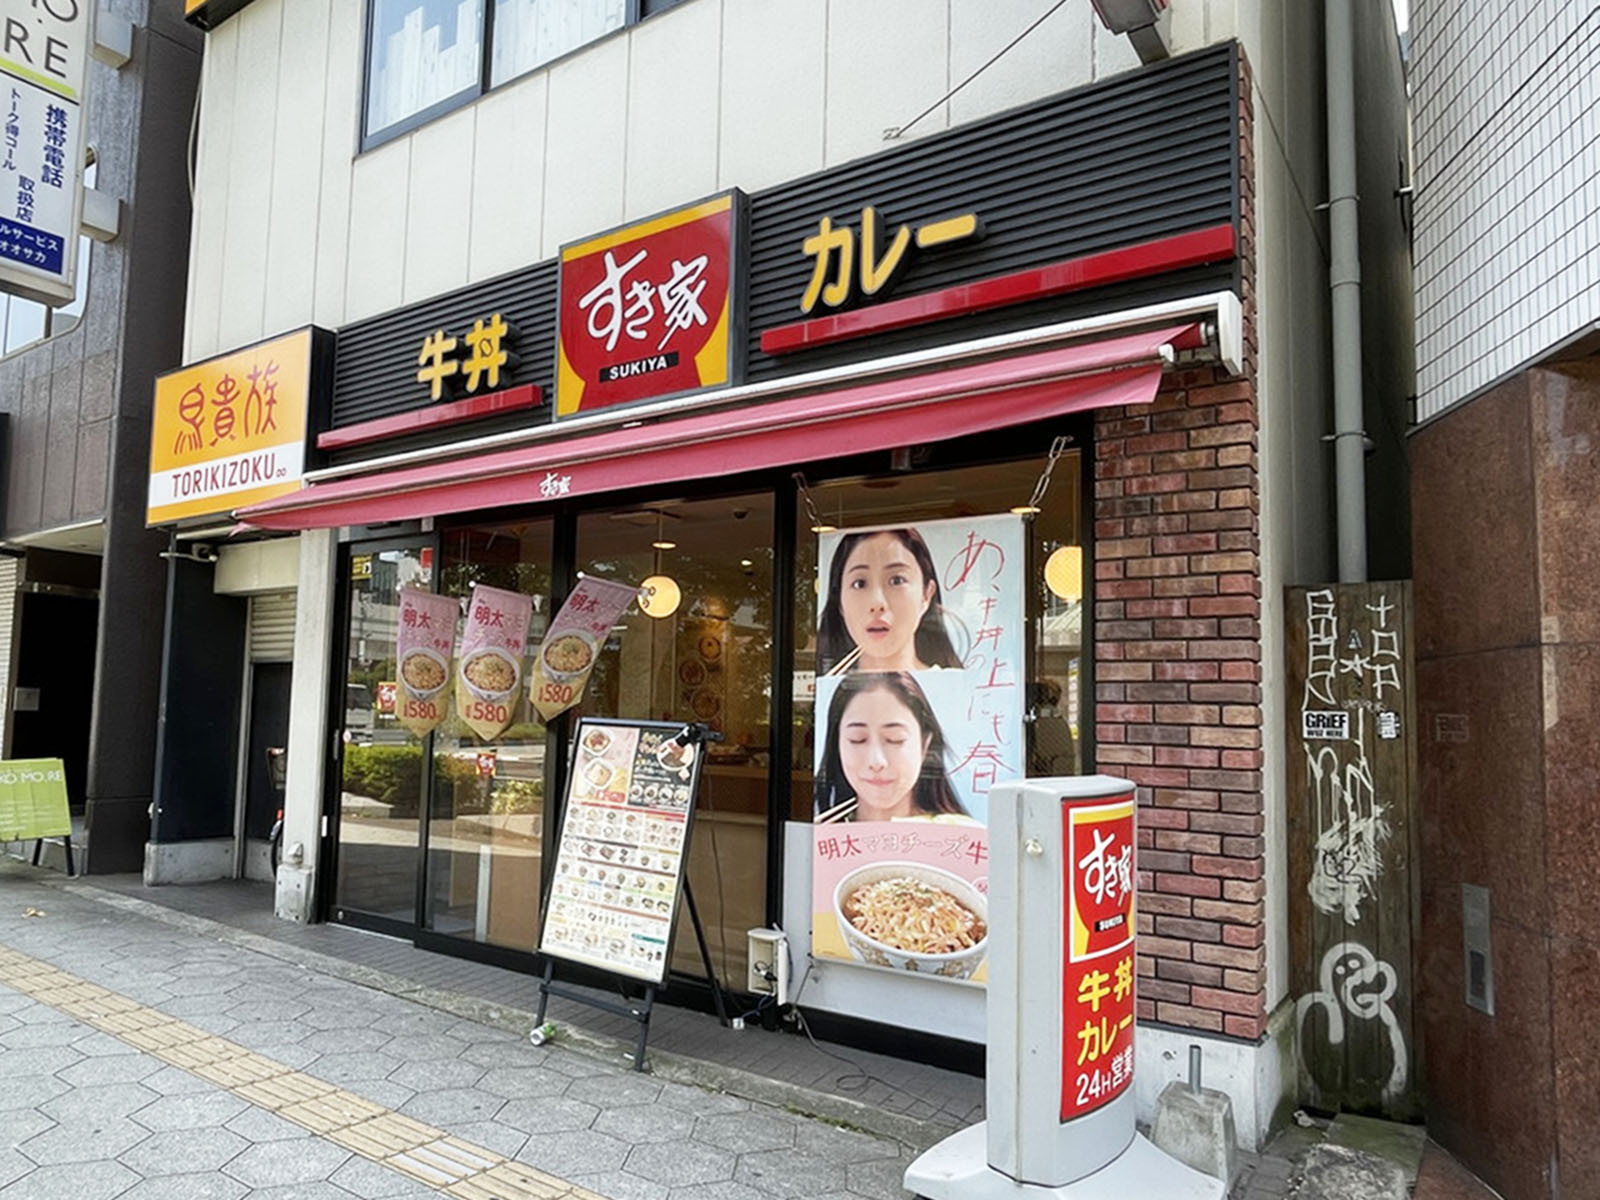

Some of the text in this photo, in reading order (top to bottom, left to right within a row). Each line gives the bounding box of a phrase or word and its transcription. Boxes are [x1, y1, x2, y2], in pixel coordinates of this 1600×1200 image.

[41, 104, 68, 189] 携帯電話
[16, 175, 35, 223] 取扱店
[801, 206, 977, 313] カレー
[578, 249, 709, 351] すき家
[417, 313, 509, 400] 牛丼
[609, 354, 668, 380] SUKIYA
[172, 453, 277, 498] TORIKIZOKU
[539, 472, 572, 497] すき家
[472, 701, 507, 724] 580
[1078, 829, 1132, 907] すき家
[1077, 956, 1133, 1013] 牛丼
[1077, 1013, 1133, 1067] カレー
[1076, 1045, 1133, 1106] 24H営業
